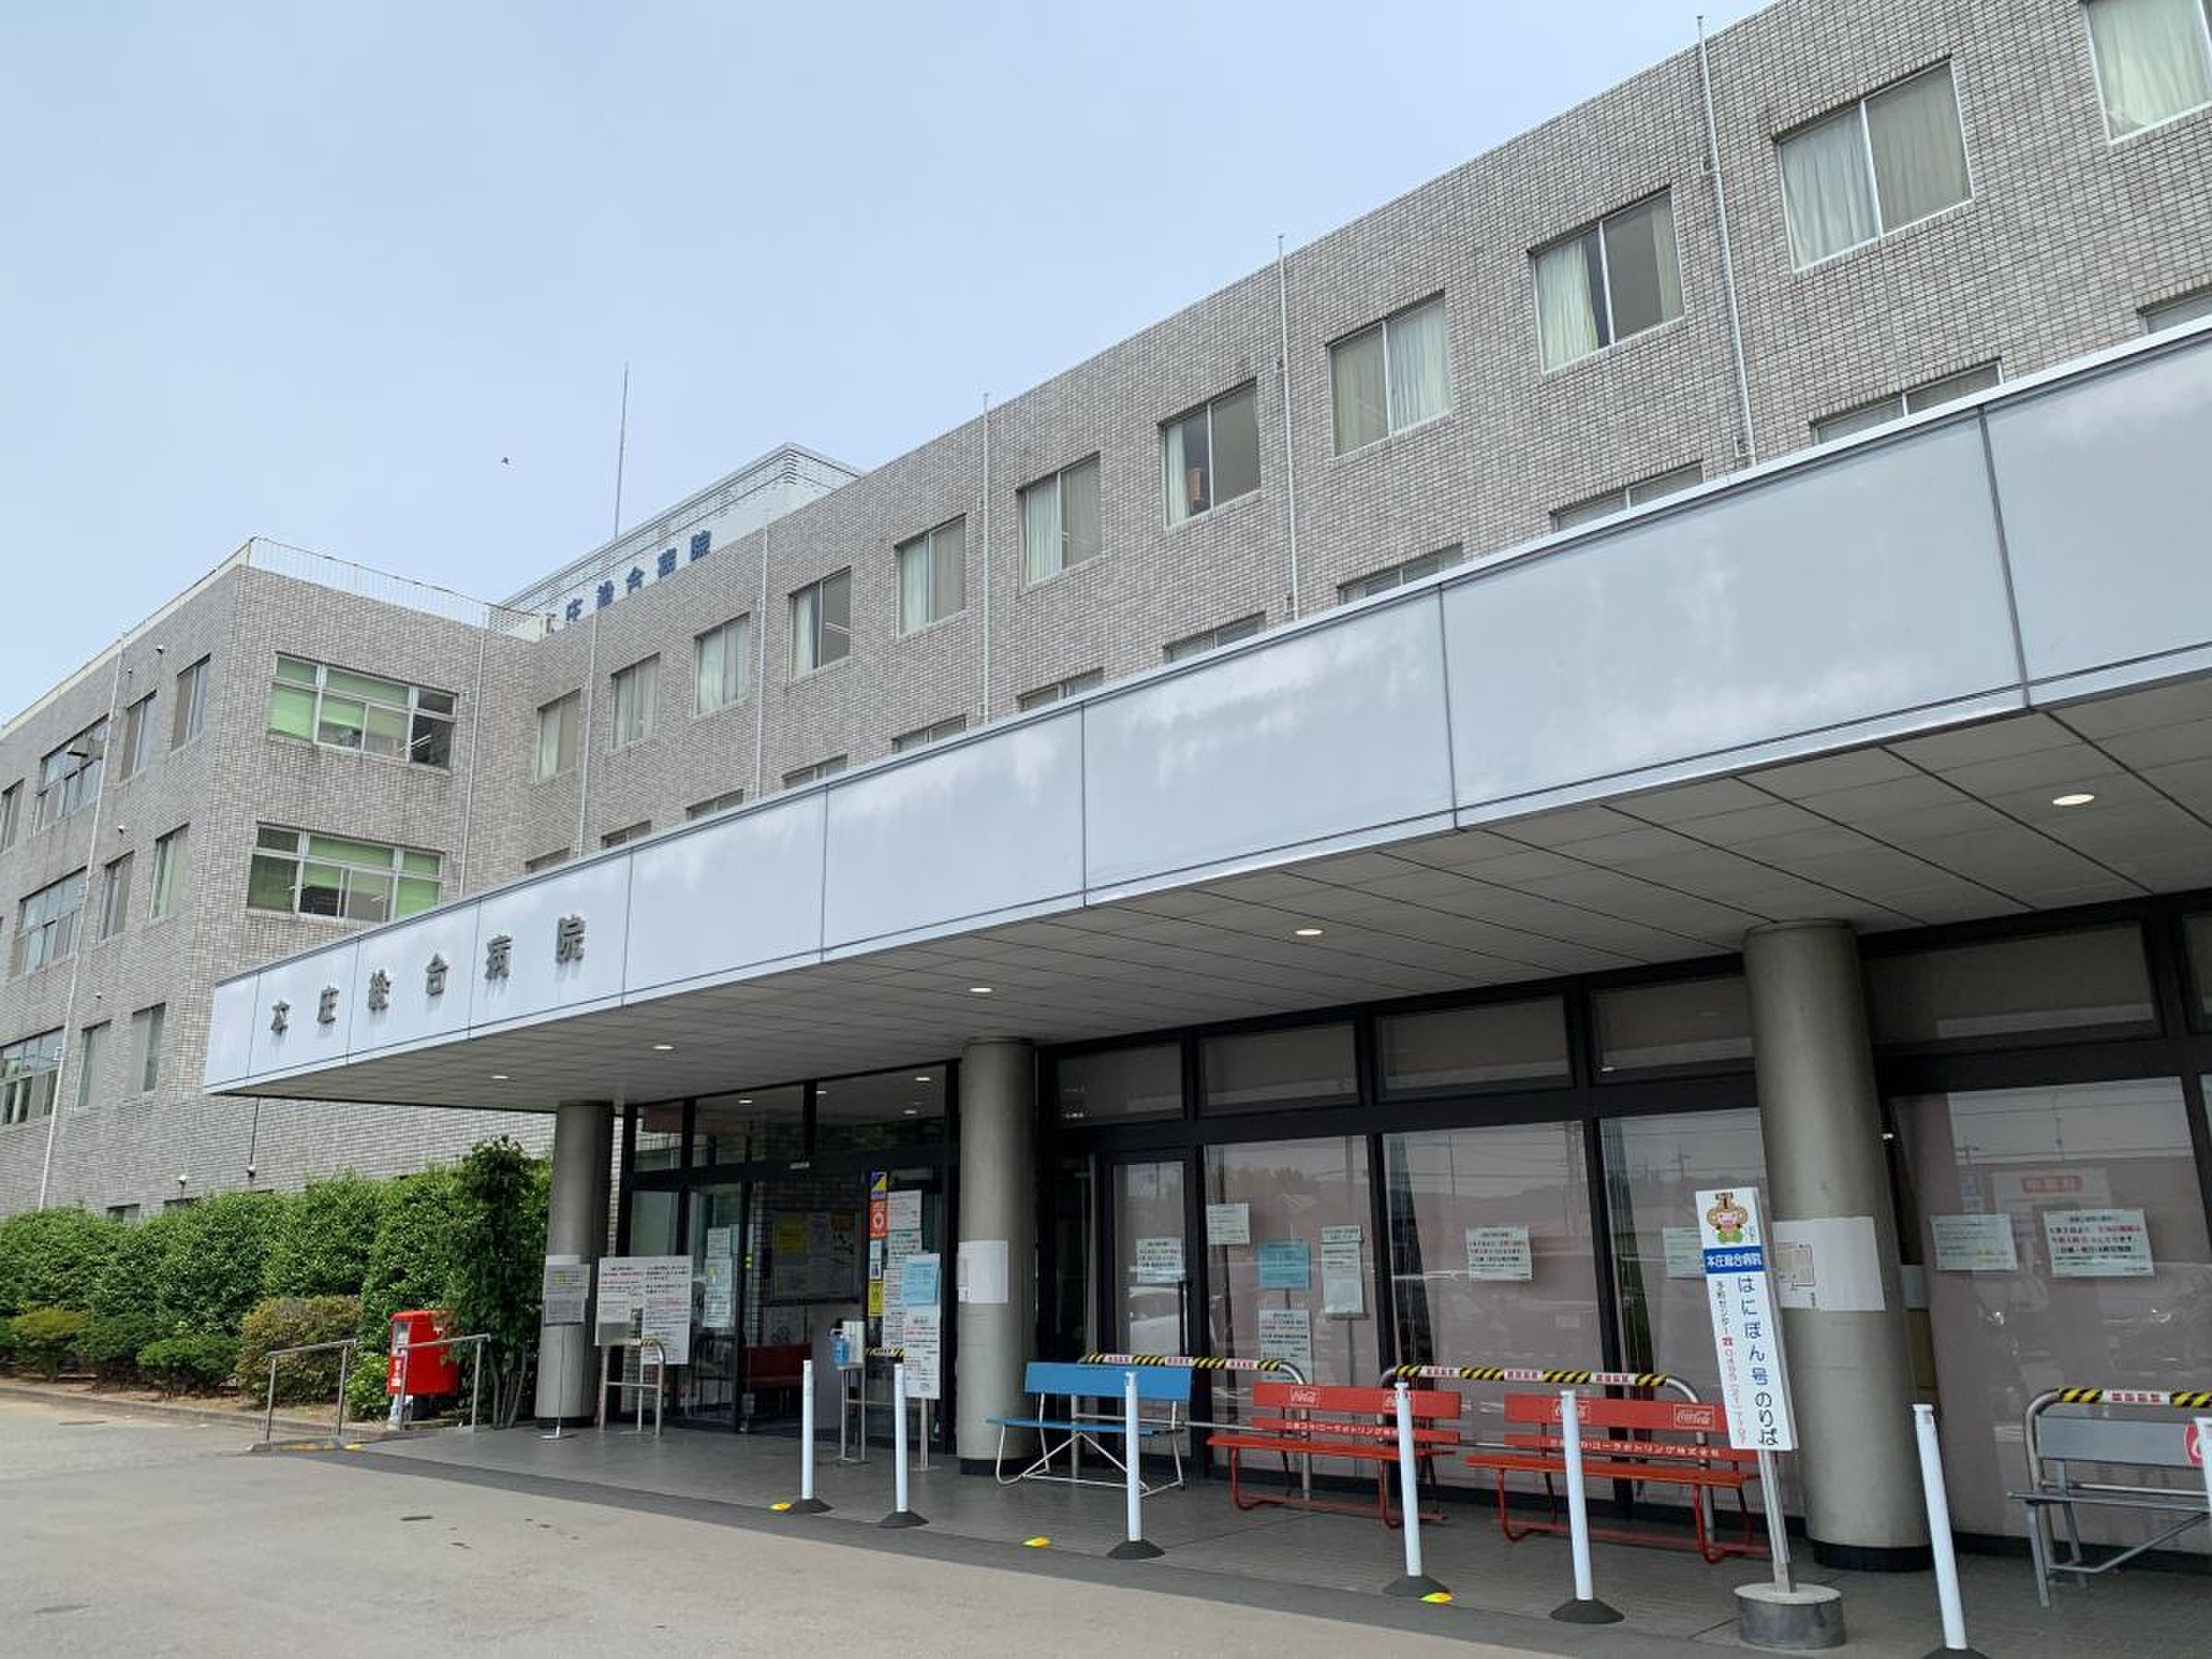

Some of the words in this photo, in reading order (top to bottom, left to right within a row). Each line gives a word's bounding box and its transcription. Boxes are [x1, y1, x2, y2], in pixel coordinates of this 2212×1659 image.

[271, 914, 586, 1034] 本庄総合病院
